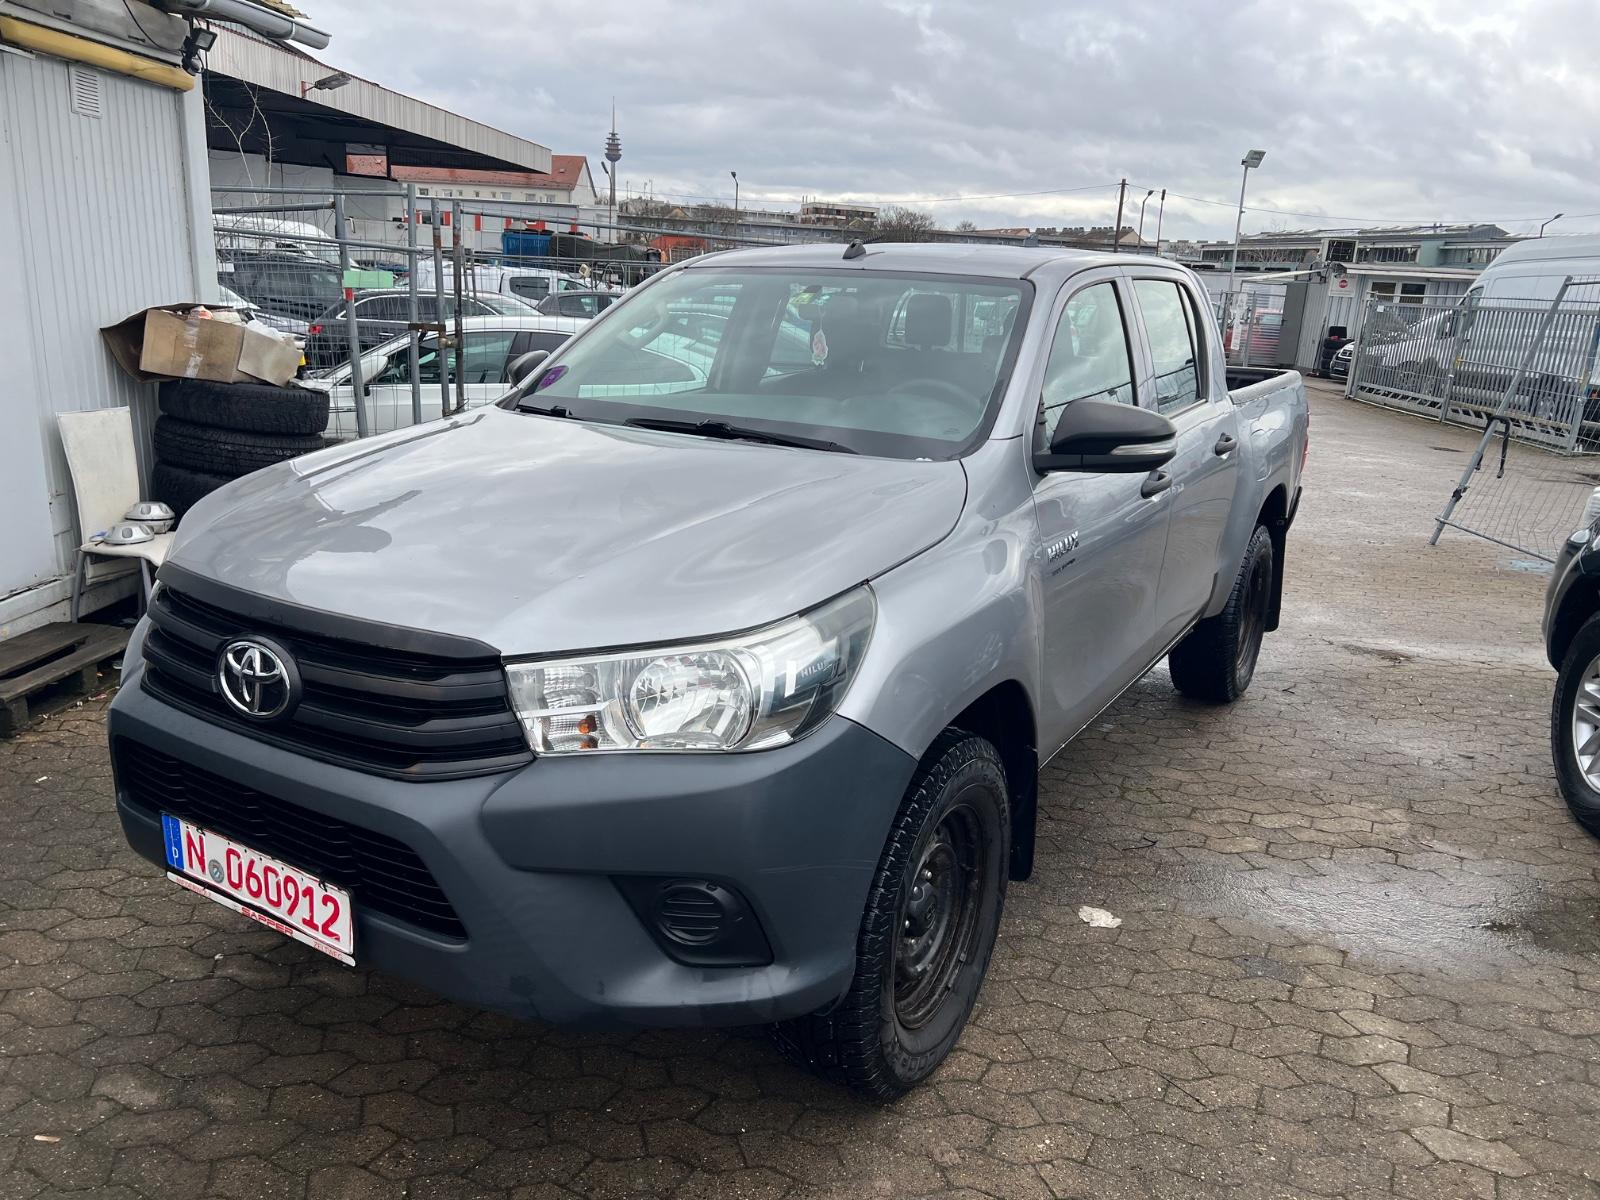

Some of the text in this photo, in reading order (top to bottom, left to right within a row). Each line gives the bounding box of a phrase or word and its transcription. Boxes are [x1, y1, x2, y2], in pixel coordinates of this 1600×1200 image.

[1047, 531, 1079, 562] HILUX
[172, 846, 179, 858] D
[185, 830, 341, 942] N 060912
[241, 907, 294, 937] SAPPER
